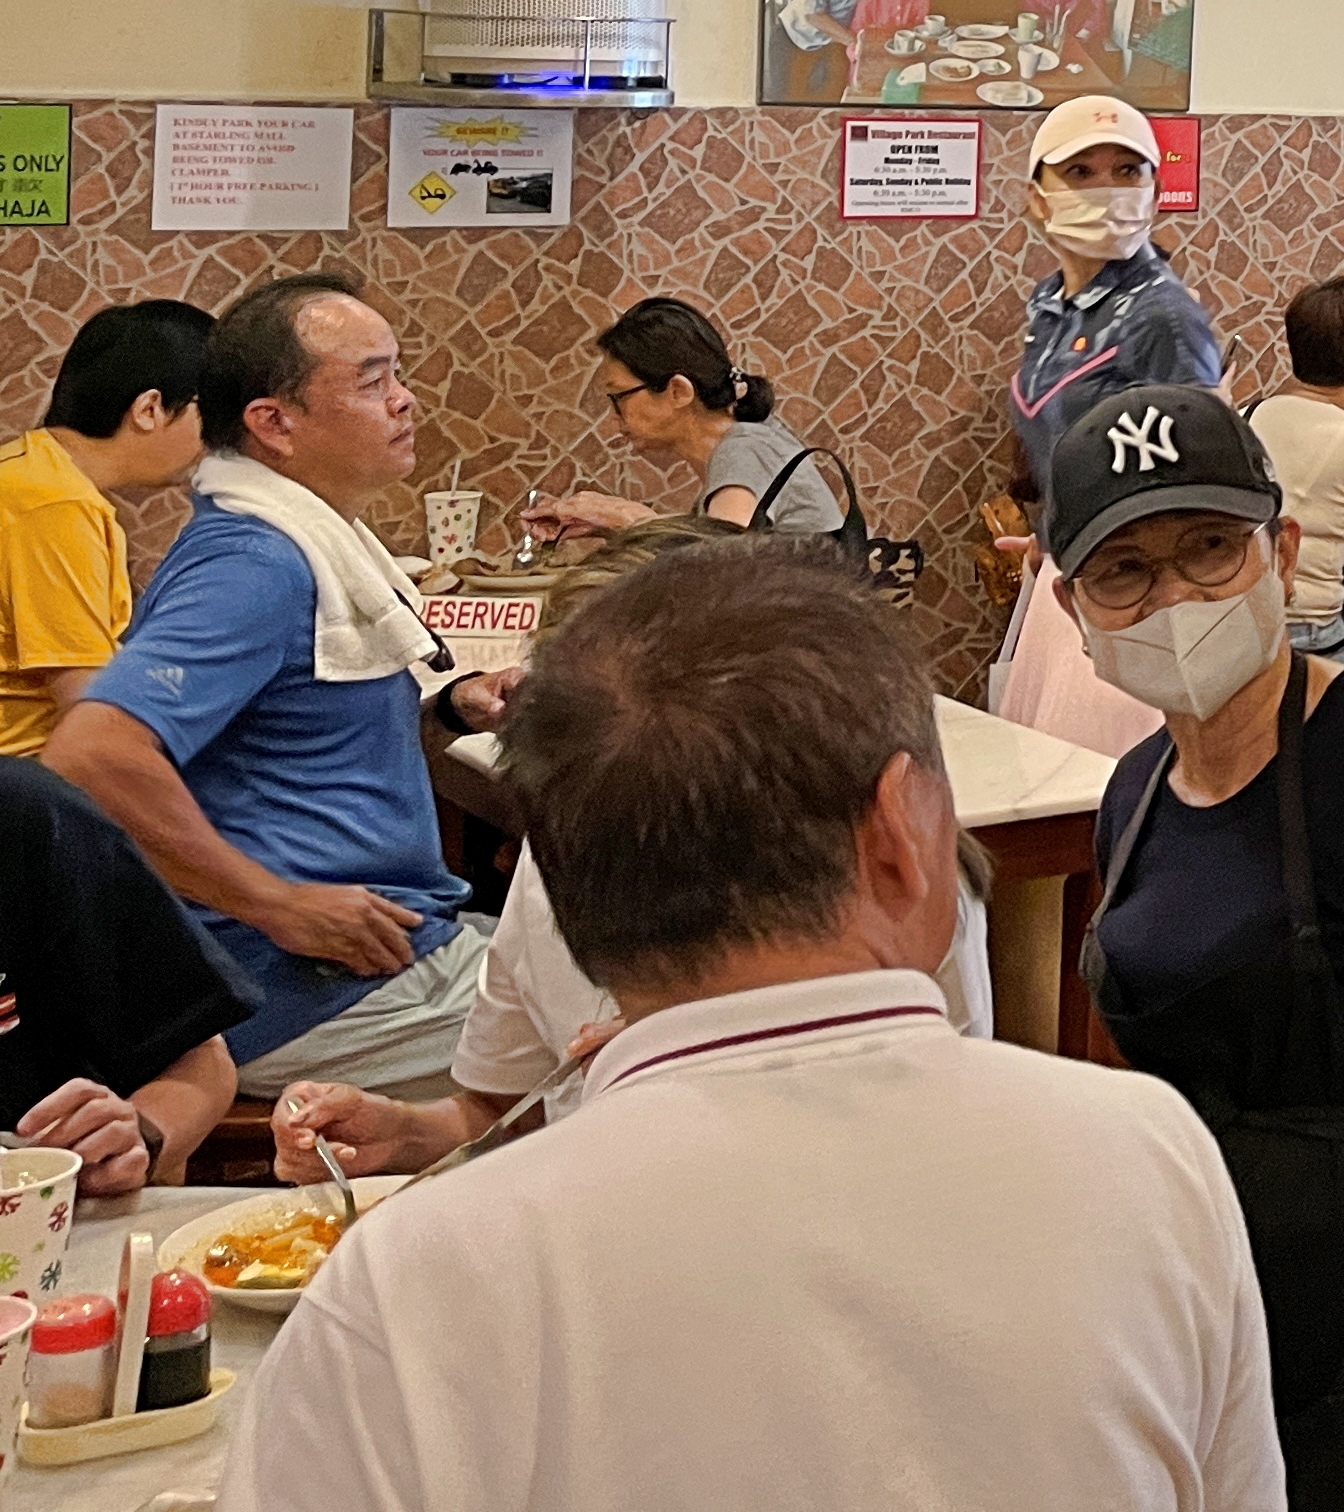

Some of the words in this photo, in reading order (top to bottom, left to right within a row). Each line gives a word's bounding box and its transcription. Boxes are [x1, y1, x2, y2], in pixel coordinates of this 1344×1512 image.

[221, 118, 253, 128] PARK
[257, 119, 290, 128] YOUR
[291, 120, 316, 129] CAR
[871, 129, 903, 140] Village
[905, 129, 925, 140] Park
[927, 129, 976, 140] Restaurant
[890, 145, 913, 154] OPEN
[914, 145, 939, 154] FROM
[13, 153, 65, 172] ONLY
[424, 599, 536, 630] ESERVED
